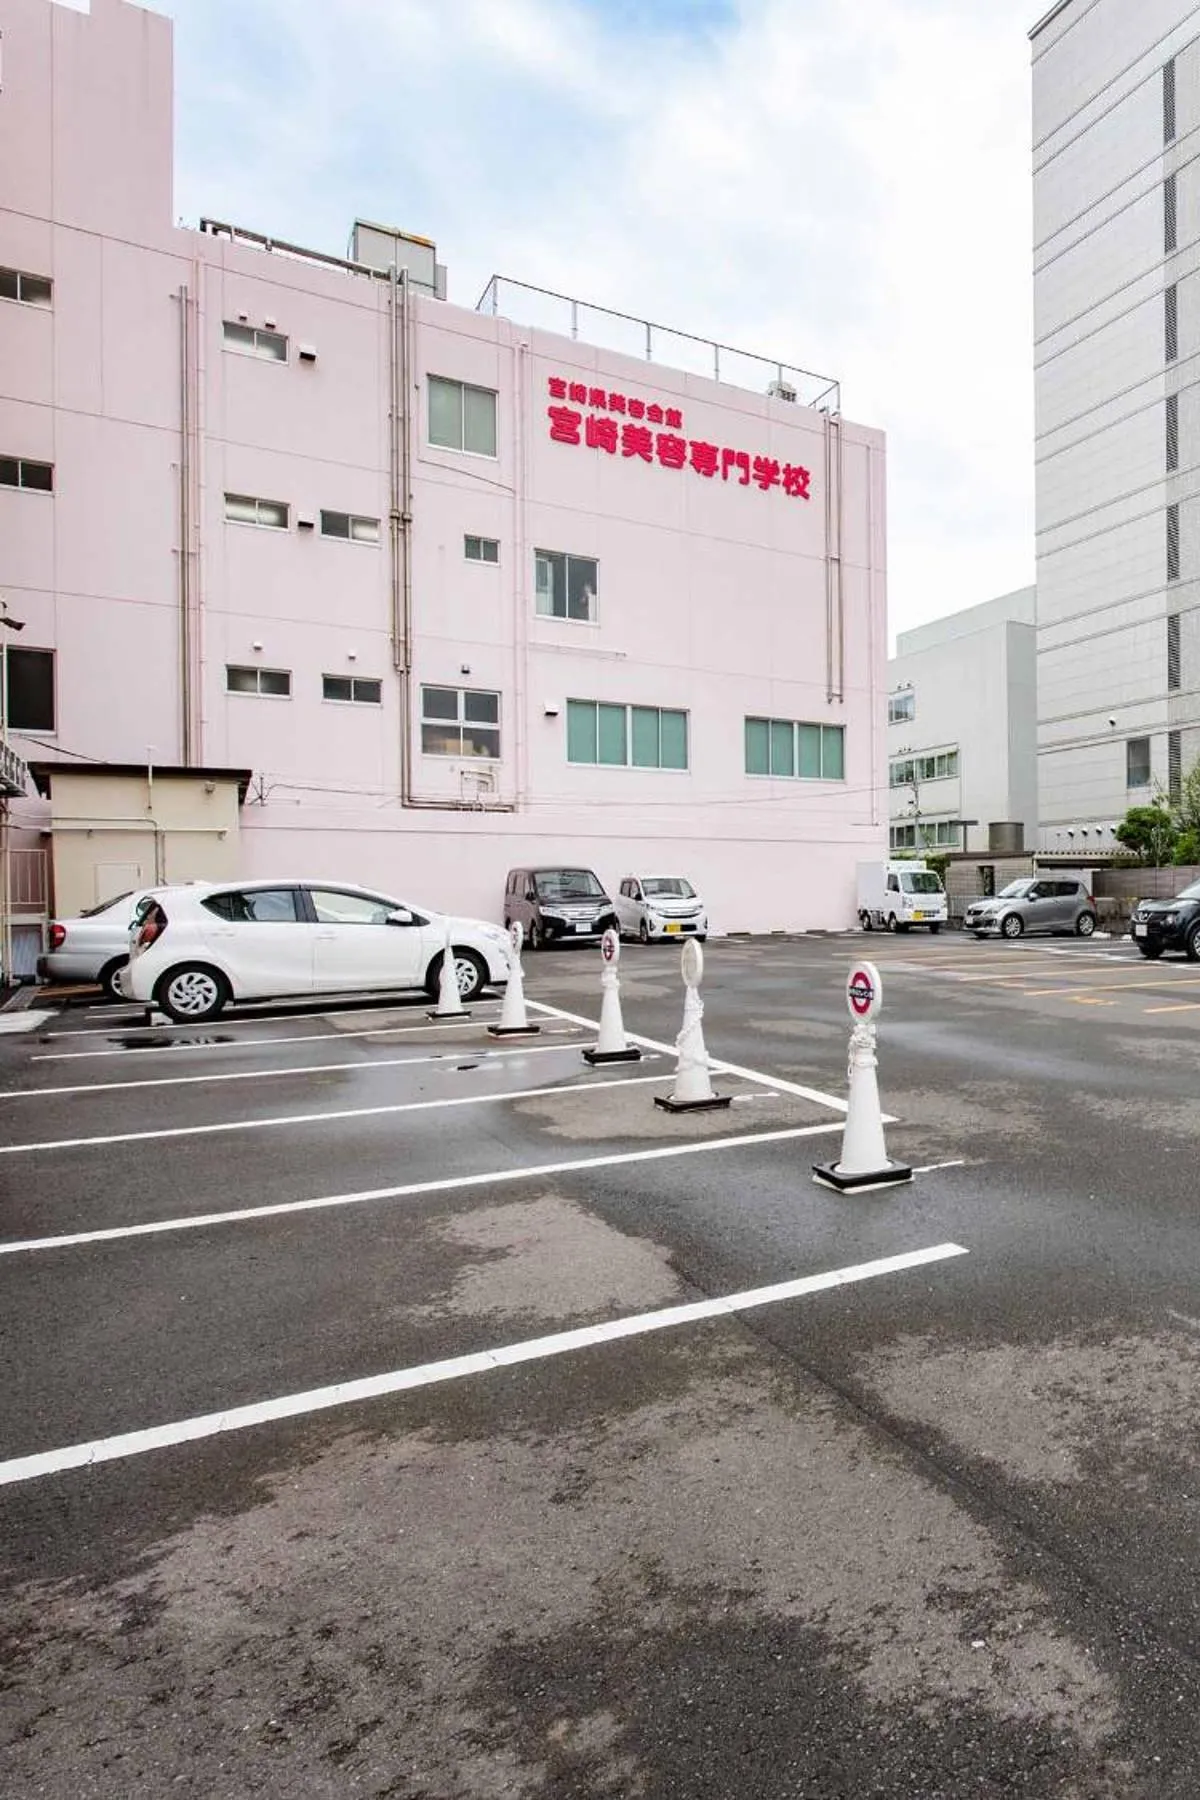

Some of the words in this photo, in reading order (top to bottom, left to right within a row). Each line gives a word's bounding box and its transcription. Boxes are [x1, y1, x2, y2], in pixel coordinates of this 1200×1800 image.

[548, 406, 810, 500] 宮崎美容専門学校
